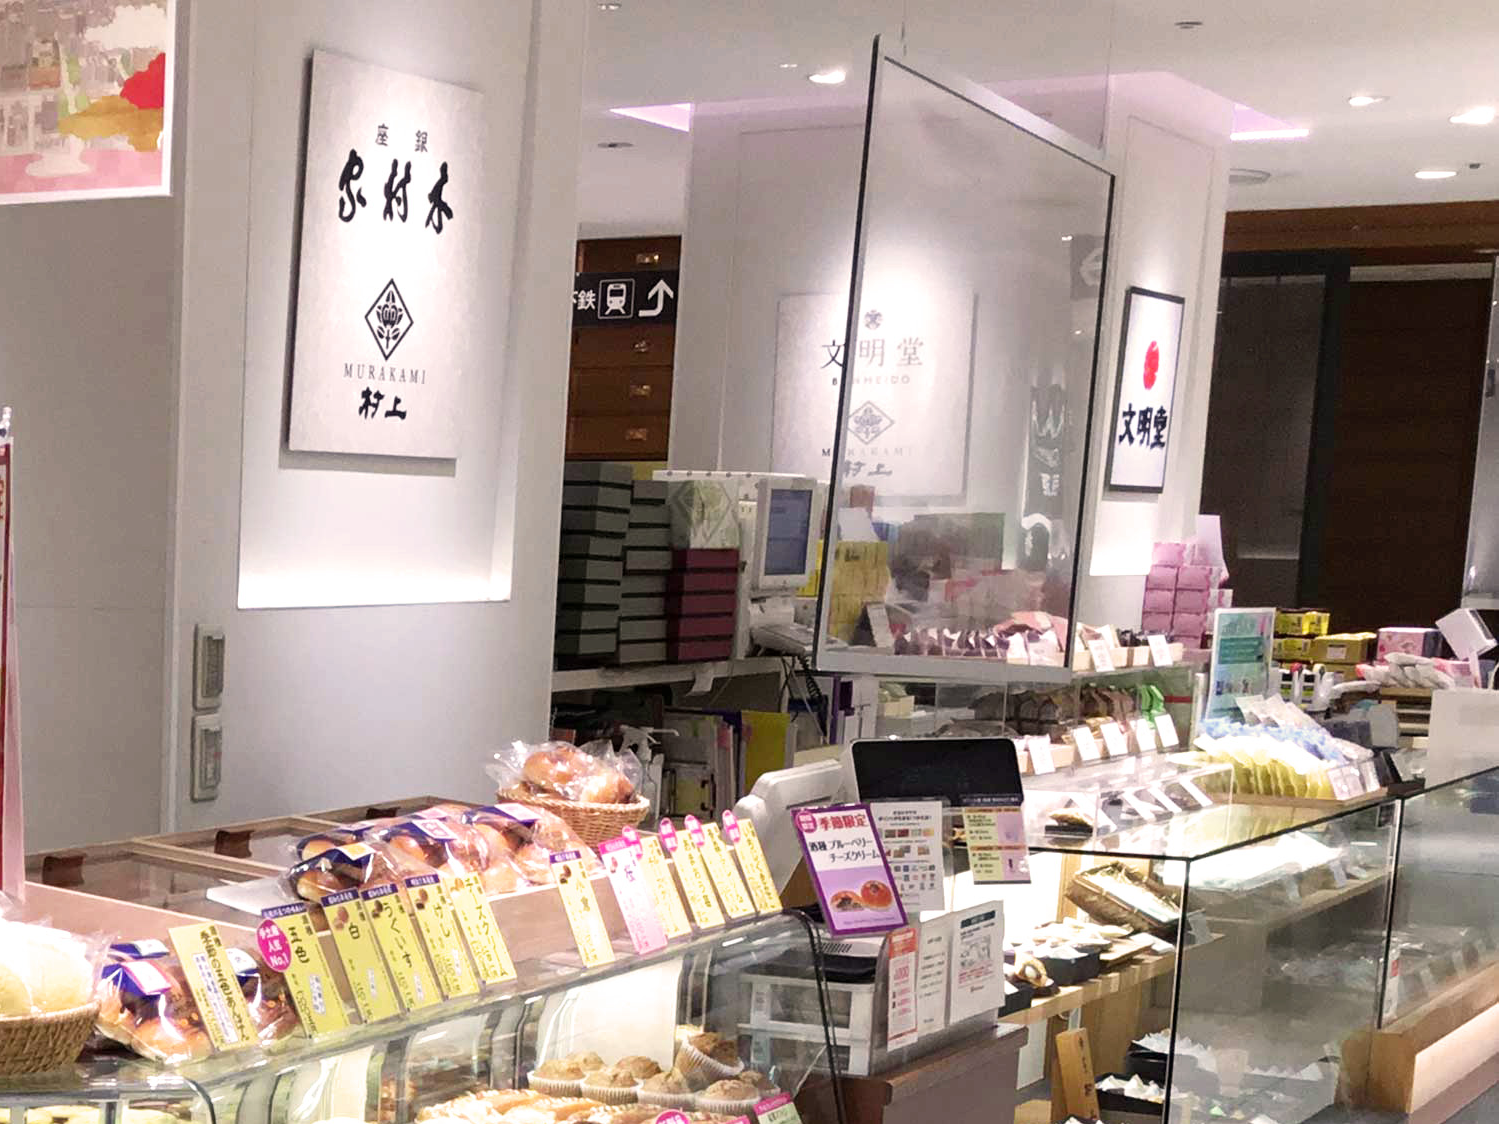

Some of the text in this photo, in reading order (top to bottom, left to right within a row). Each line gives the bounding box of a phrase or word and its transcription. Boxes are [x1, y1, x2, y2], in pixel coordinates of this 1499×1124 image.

[821, 336, 924, 369] 文明堂
[343, 362, 427, 386] MURAKAMI
[358, 387, 407, 420] 村上
[1118, 402, 1168, 449] 文明堂
[819, 813, 868, 832] 季節限定
[829, 849, 881, 863] チーズクリーム
[830, 837, 873, 850] ブルーベリー
[287, 926, 310, 964] 五色
